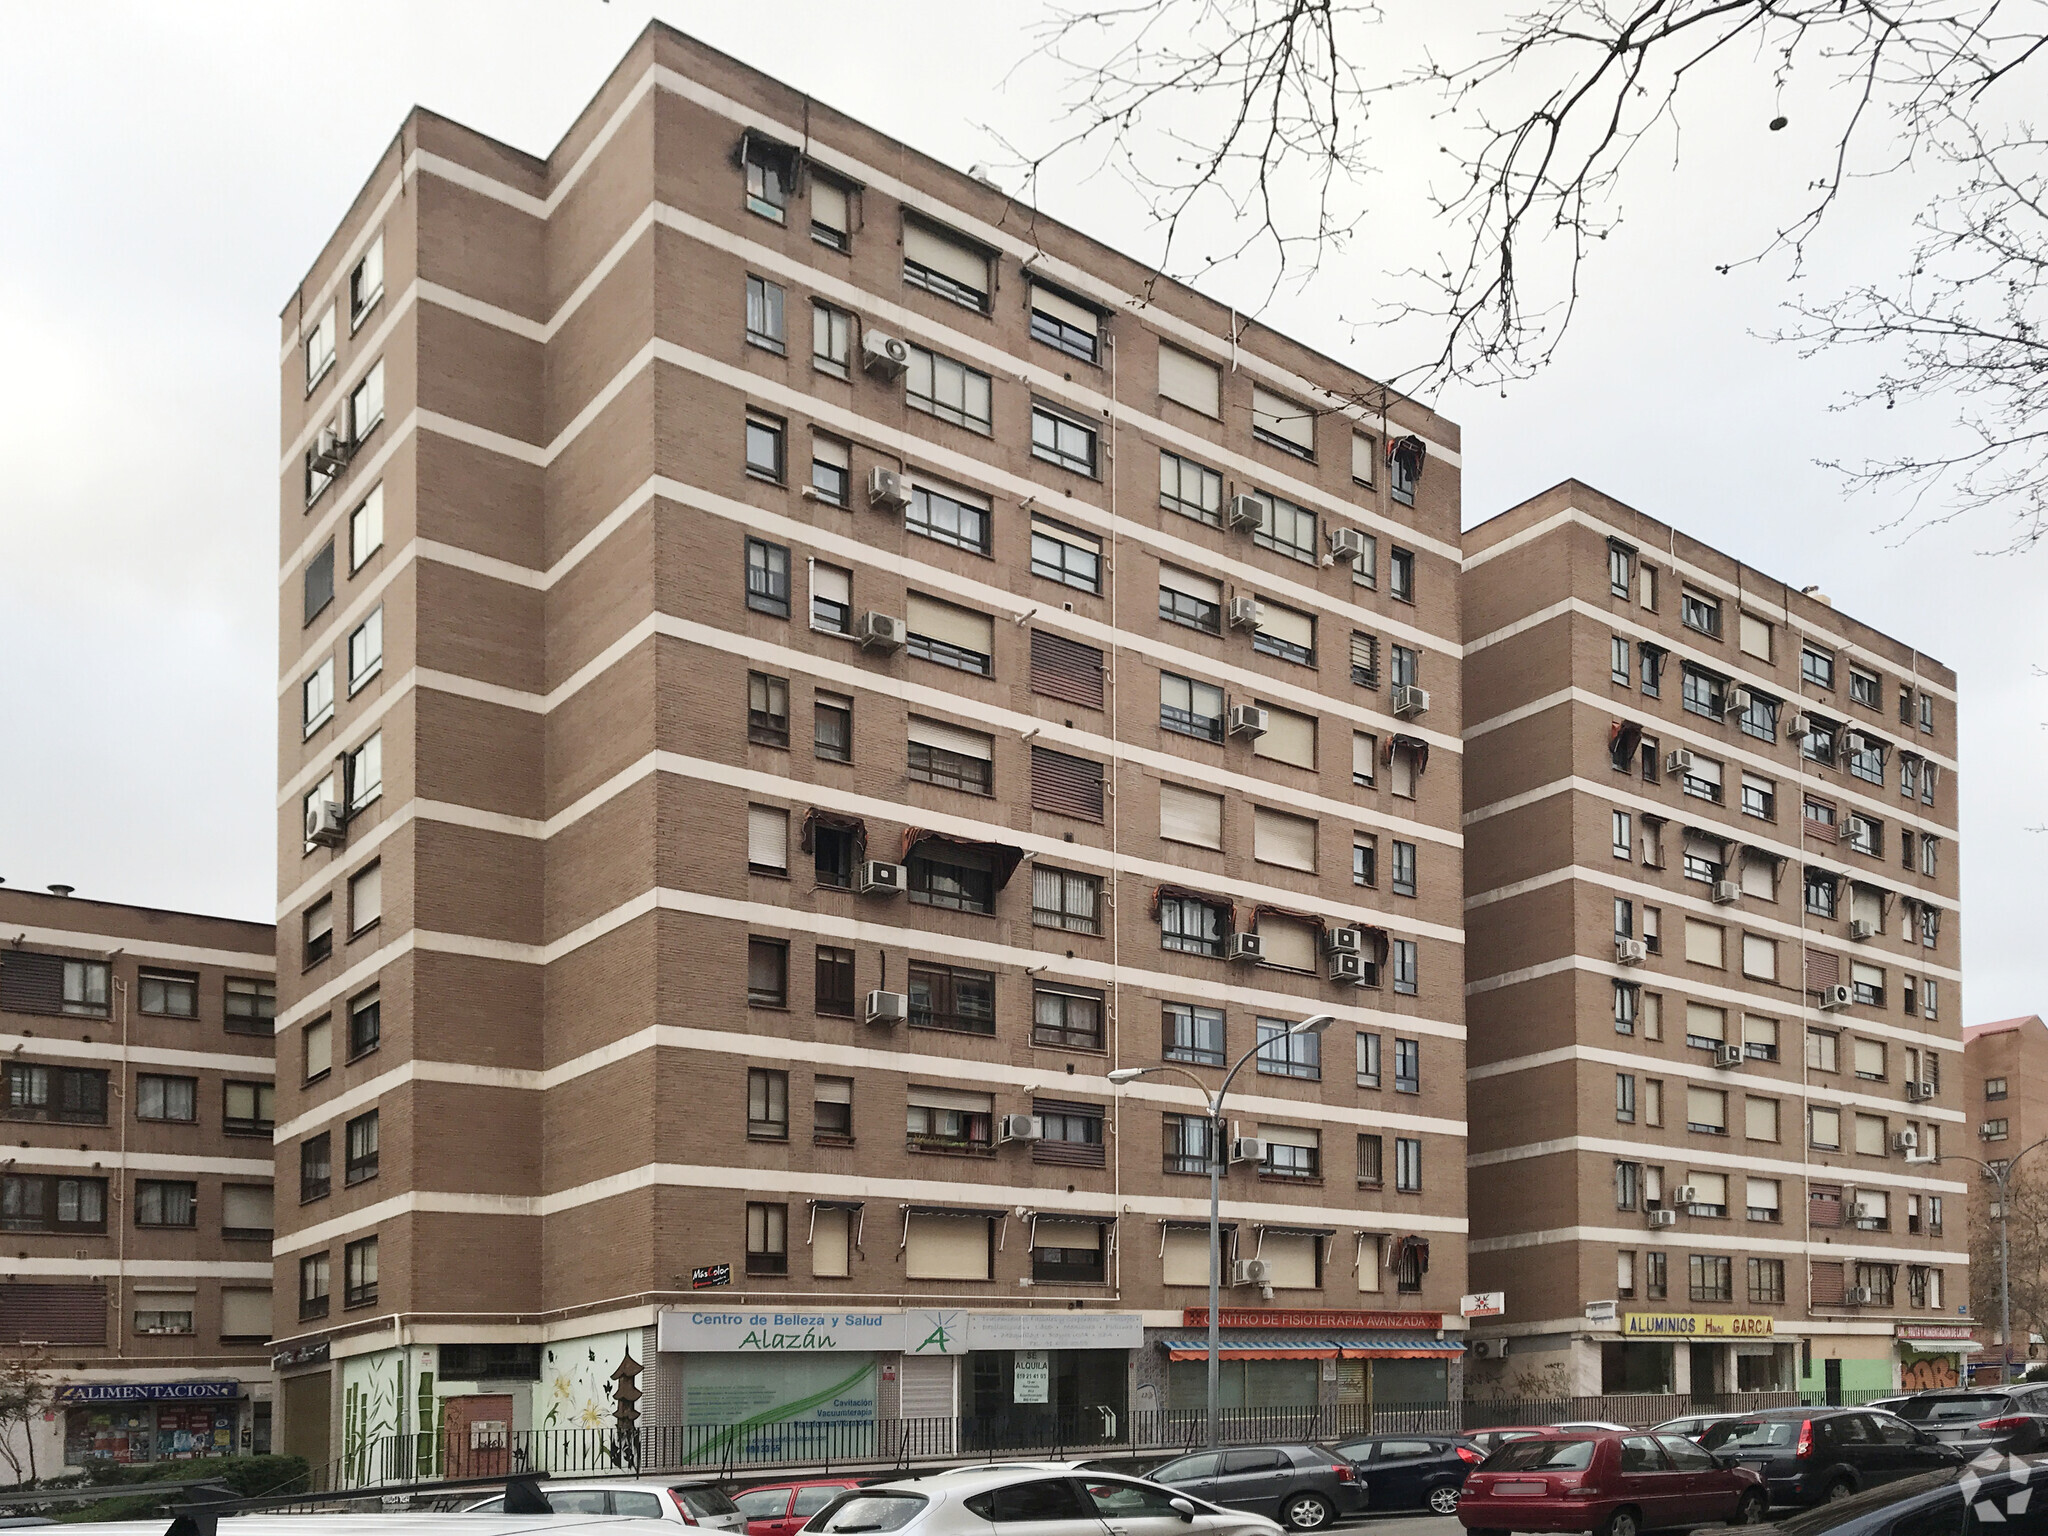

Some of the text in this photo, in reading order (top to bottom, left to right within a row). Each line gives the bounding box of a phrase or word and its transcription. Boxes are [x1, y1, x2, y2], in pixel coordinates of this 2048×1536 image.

[692, 1314, 882, 1328] Centro de Belleza y Salud
[1204, 1313, 1425, 1327] CNTRO DE FISIOTERAPIA AVANZADA
[1630, 1317, 1696, 1333] ALUMINIOS
[738, 1327, 836, 1350] Alazán
[1027, 1351, 1037, 1360] SE
[1016, 1362, 1048, 1370] ALQUILA
[833, 1399, 873, 1407] Cavitación
